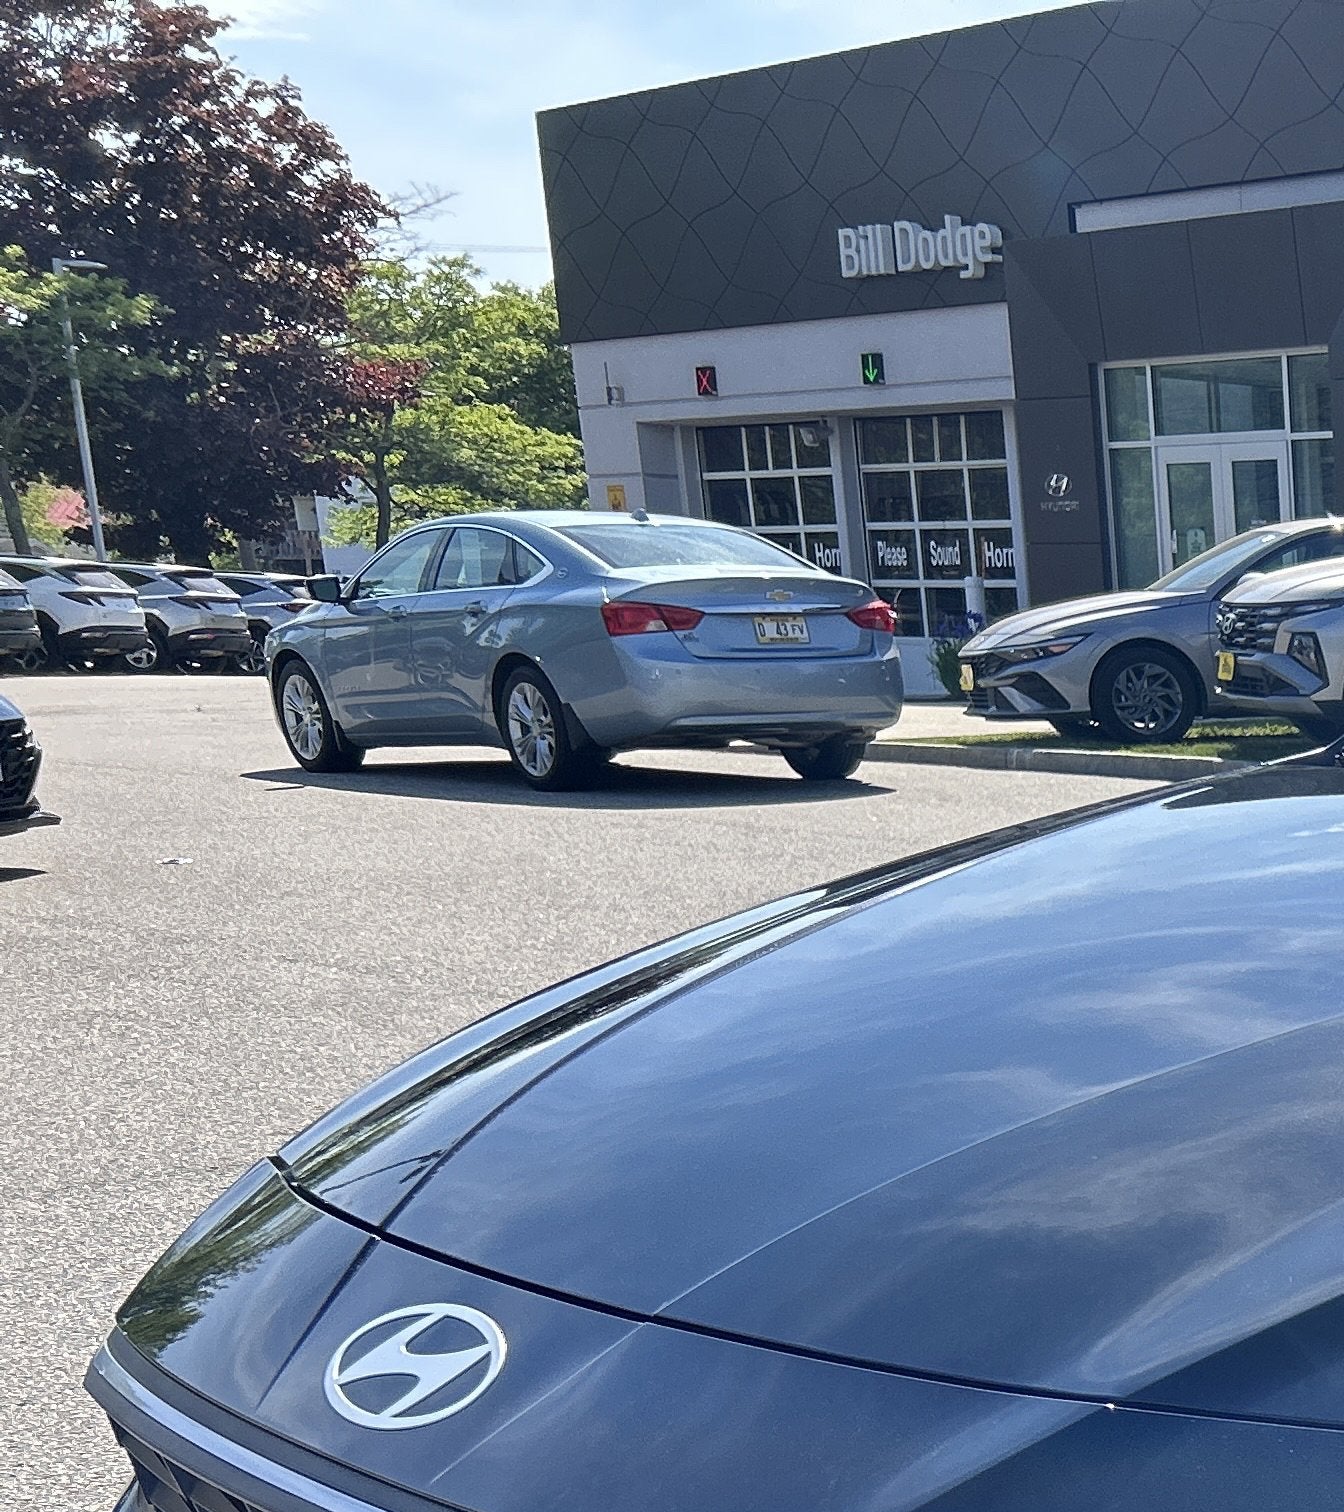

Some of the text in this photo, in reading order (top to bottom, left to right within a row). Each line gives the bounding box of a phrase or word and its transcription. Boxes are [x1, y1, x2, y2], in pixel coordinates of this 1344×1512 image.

[838, 214, 1003, 279] Bill Dodge
[877, 541, 907, 566] Please
[929, 540, 961, 566] Sound
